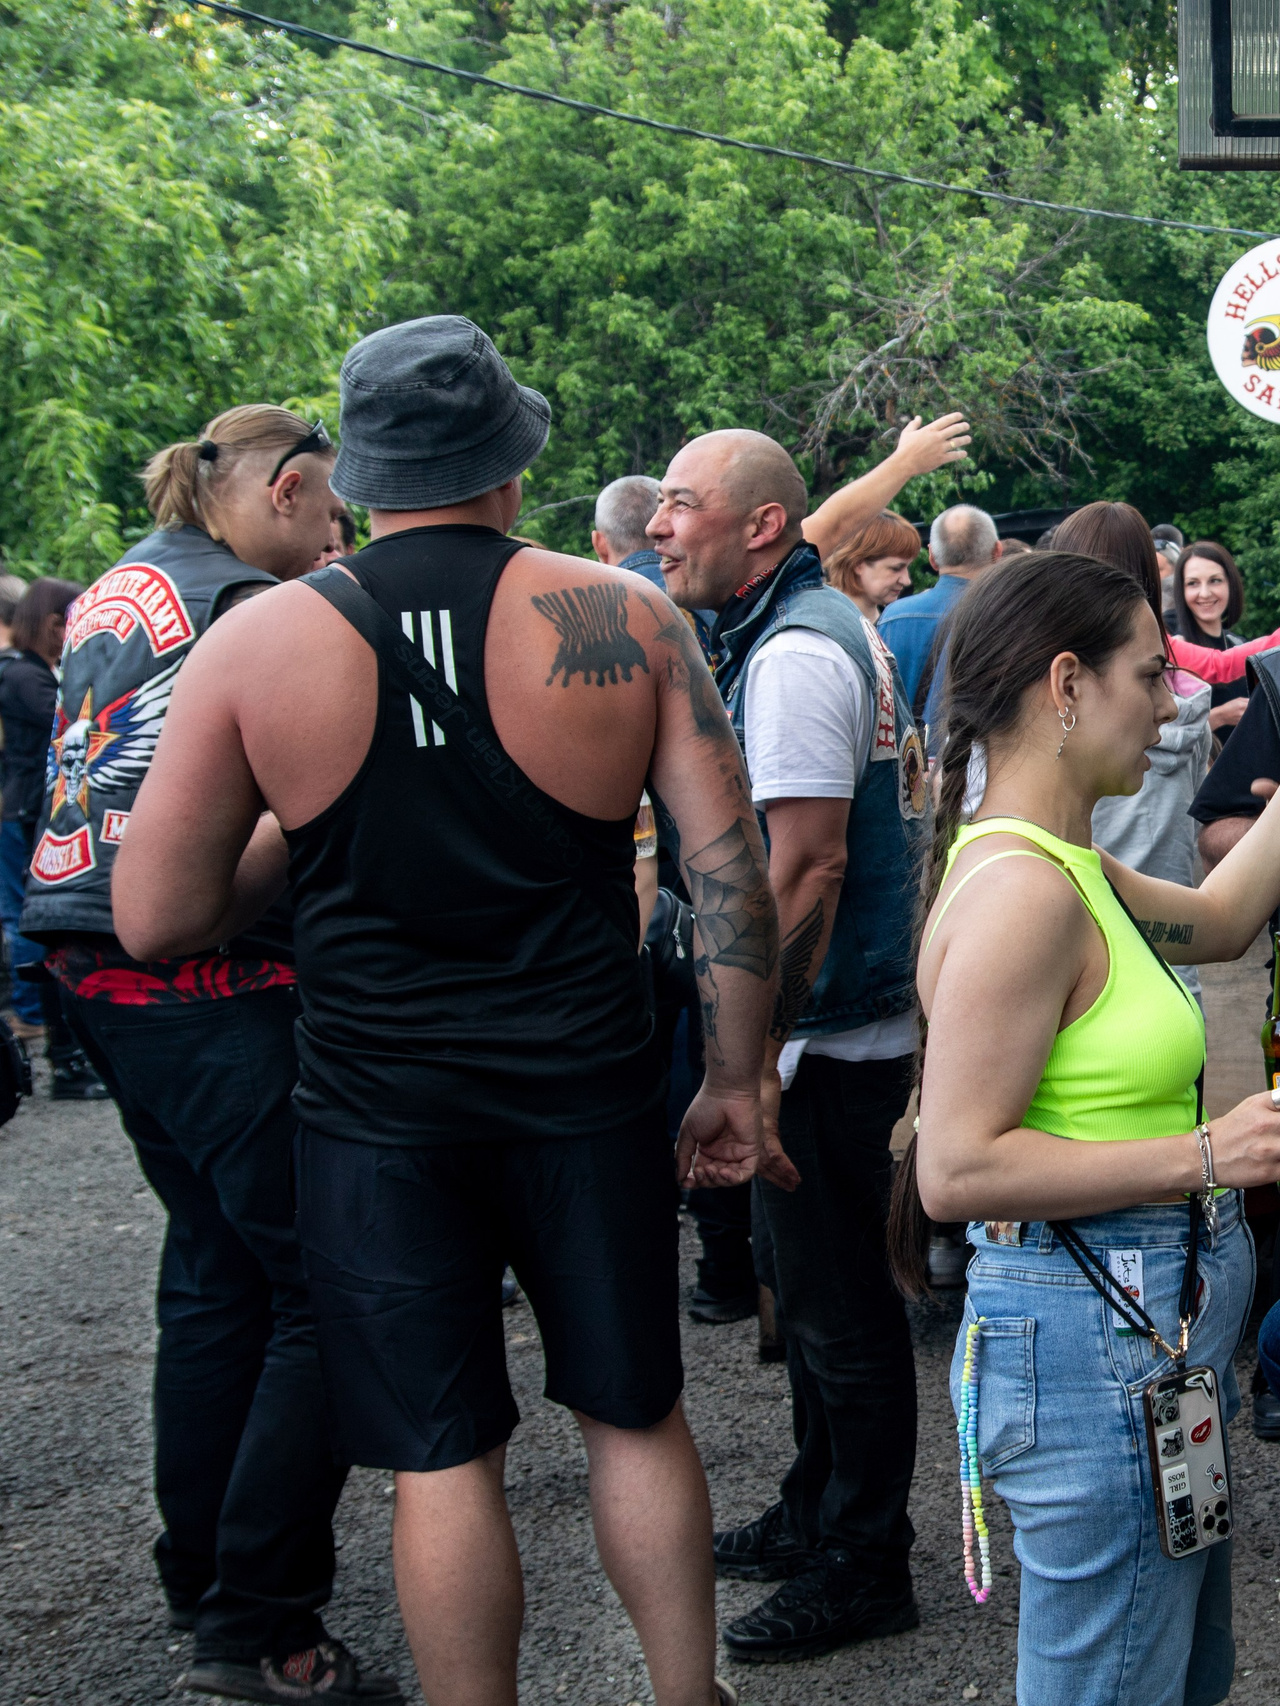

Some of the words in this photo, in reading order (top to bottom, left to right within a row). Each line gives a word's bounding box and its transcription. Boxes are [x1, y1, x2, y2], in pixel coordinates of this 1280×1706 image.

[75, 609, 121, 641] SUPPORT
[135, 579, 187, 647] ARMY
[394, 643, 470, 723] Jeans
[464, 726, 527, 799] Klein
[1167, 1471, 1186, 1484] BOSS
[1169, 1481, 1187, 1493] GIRL
